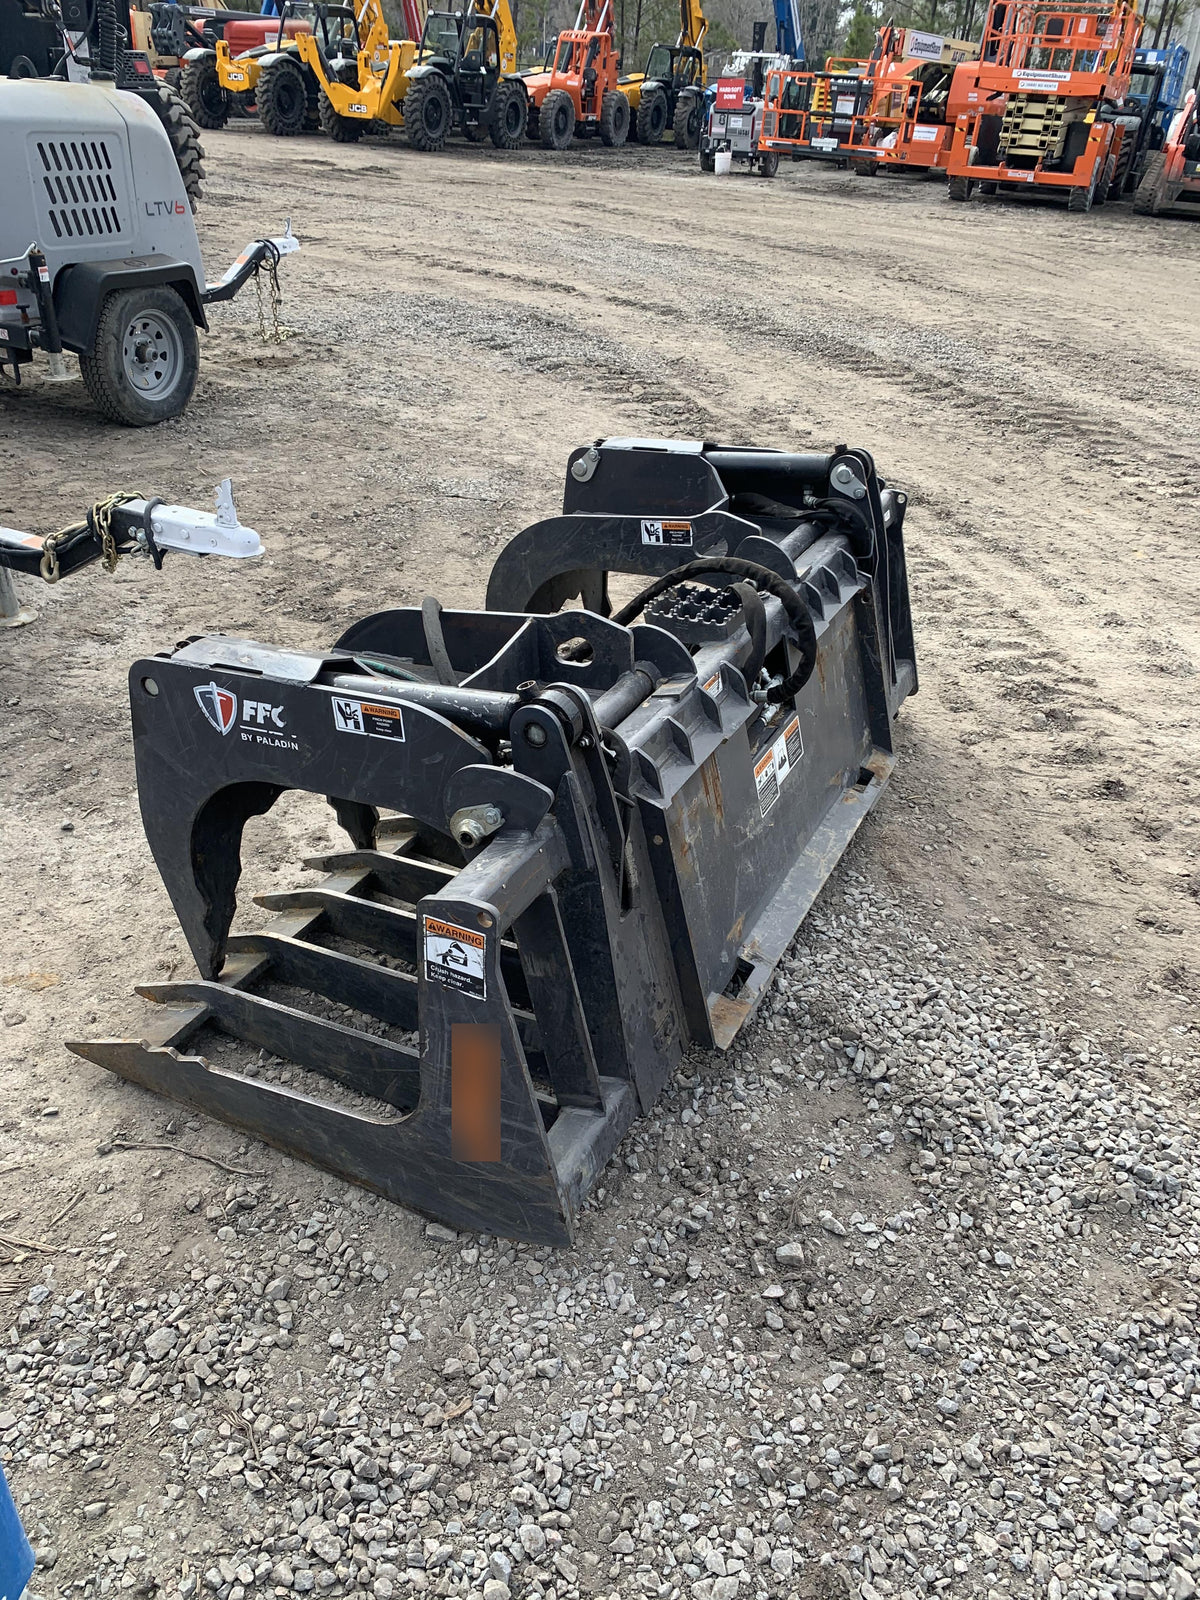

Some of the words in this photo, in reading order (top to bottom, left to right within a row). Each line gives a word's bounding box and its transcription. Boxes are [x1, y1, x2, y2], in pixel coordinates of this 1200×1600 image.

[227, 72, 244, 81] JCB
[1022, 71, 1067, 79] EquipmentShare
[348, 103, 367, 113] JCB
[145, 200, 186, 216] LTV6
[242, 699, 287, 728] FFC
[368, 706, 398, 717] WARNING
[240, 732, 253, 742] BY
[256, 735, 299, 751] PALADIN
[435, 924, 482, 946] WARNING
[430, 965, 449, 976] Crush
[430, 972, 447, 982] Keep
